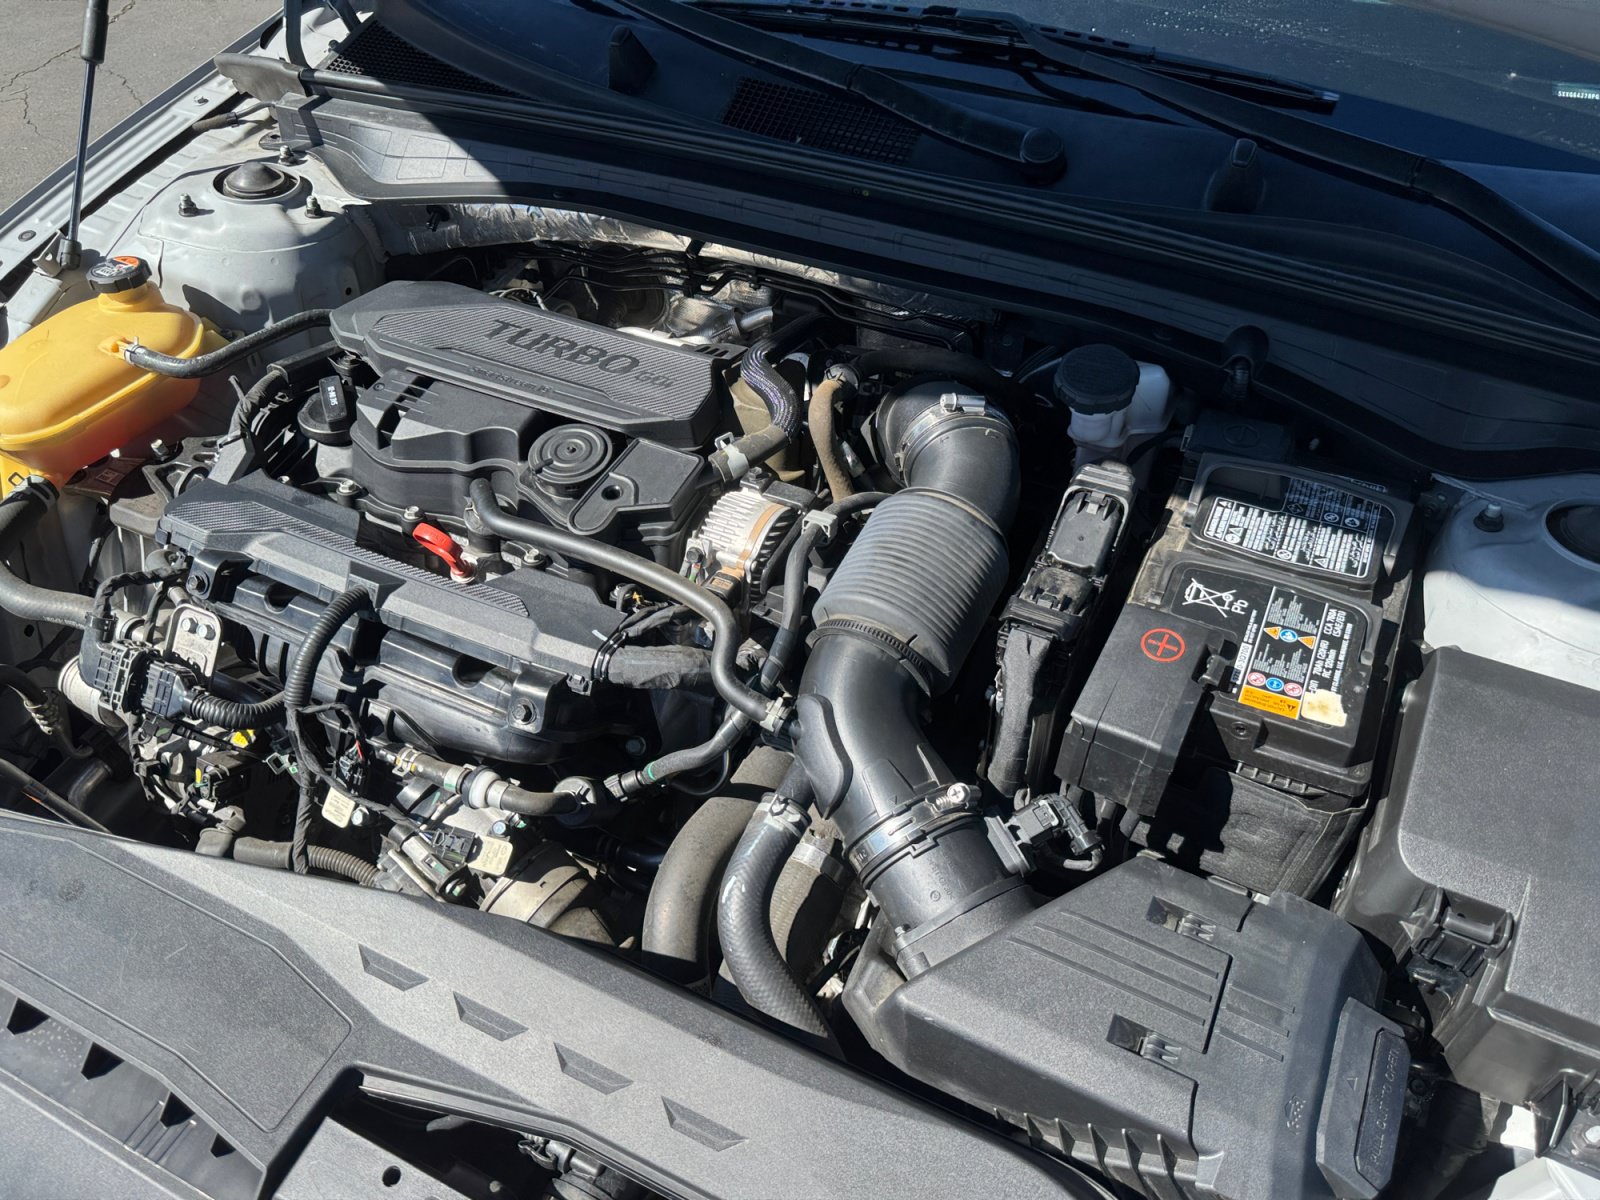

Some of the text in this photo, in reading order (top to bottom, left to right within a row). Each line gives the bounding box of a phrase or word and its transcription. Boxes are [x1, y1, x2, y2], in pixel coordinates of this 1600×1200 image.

[485, 319, 641, 375] TURBO
[1231, 599, 1249, 615] Pb
[1323, 623, 1333, 634] CCA
[1321, 669, 1332, 678] RC
[1384, 1047, 1400, 1082] OPEN
[1375, 1101, 1388, 1129] OUT
[1370, 1133, 1385, 1164] PULL
